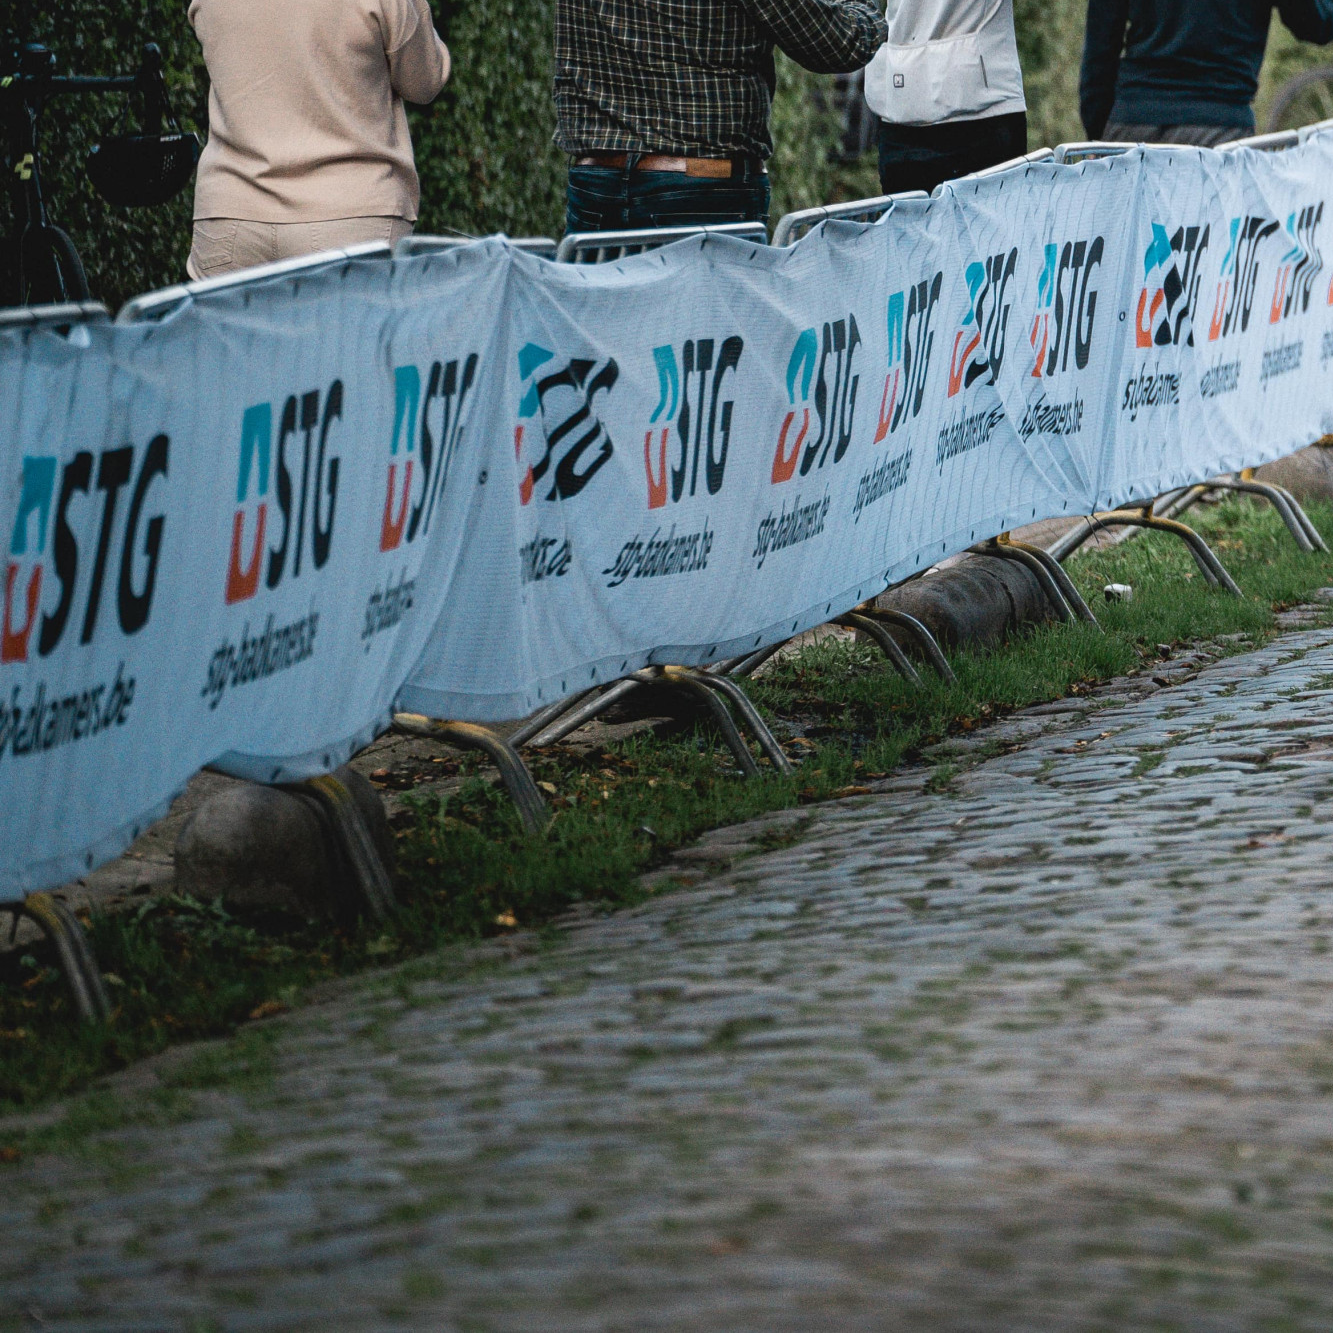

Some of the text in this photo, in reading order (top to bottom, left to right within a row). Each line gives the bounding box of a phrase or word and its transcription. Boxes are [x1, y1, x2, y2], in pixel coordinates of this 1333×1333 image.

[890, 271, 943, 434] STG
[1046, 236, 1105, 377] STG
[1222, 215, 1280, 338] STG
[671, 335, 744, 503] STG
[800, 312, 862, 477] STG
[38, 433, 171, 658] STG
[266, 379, 343, 591] STG
